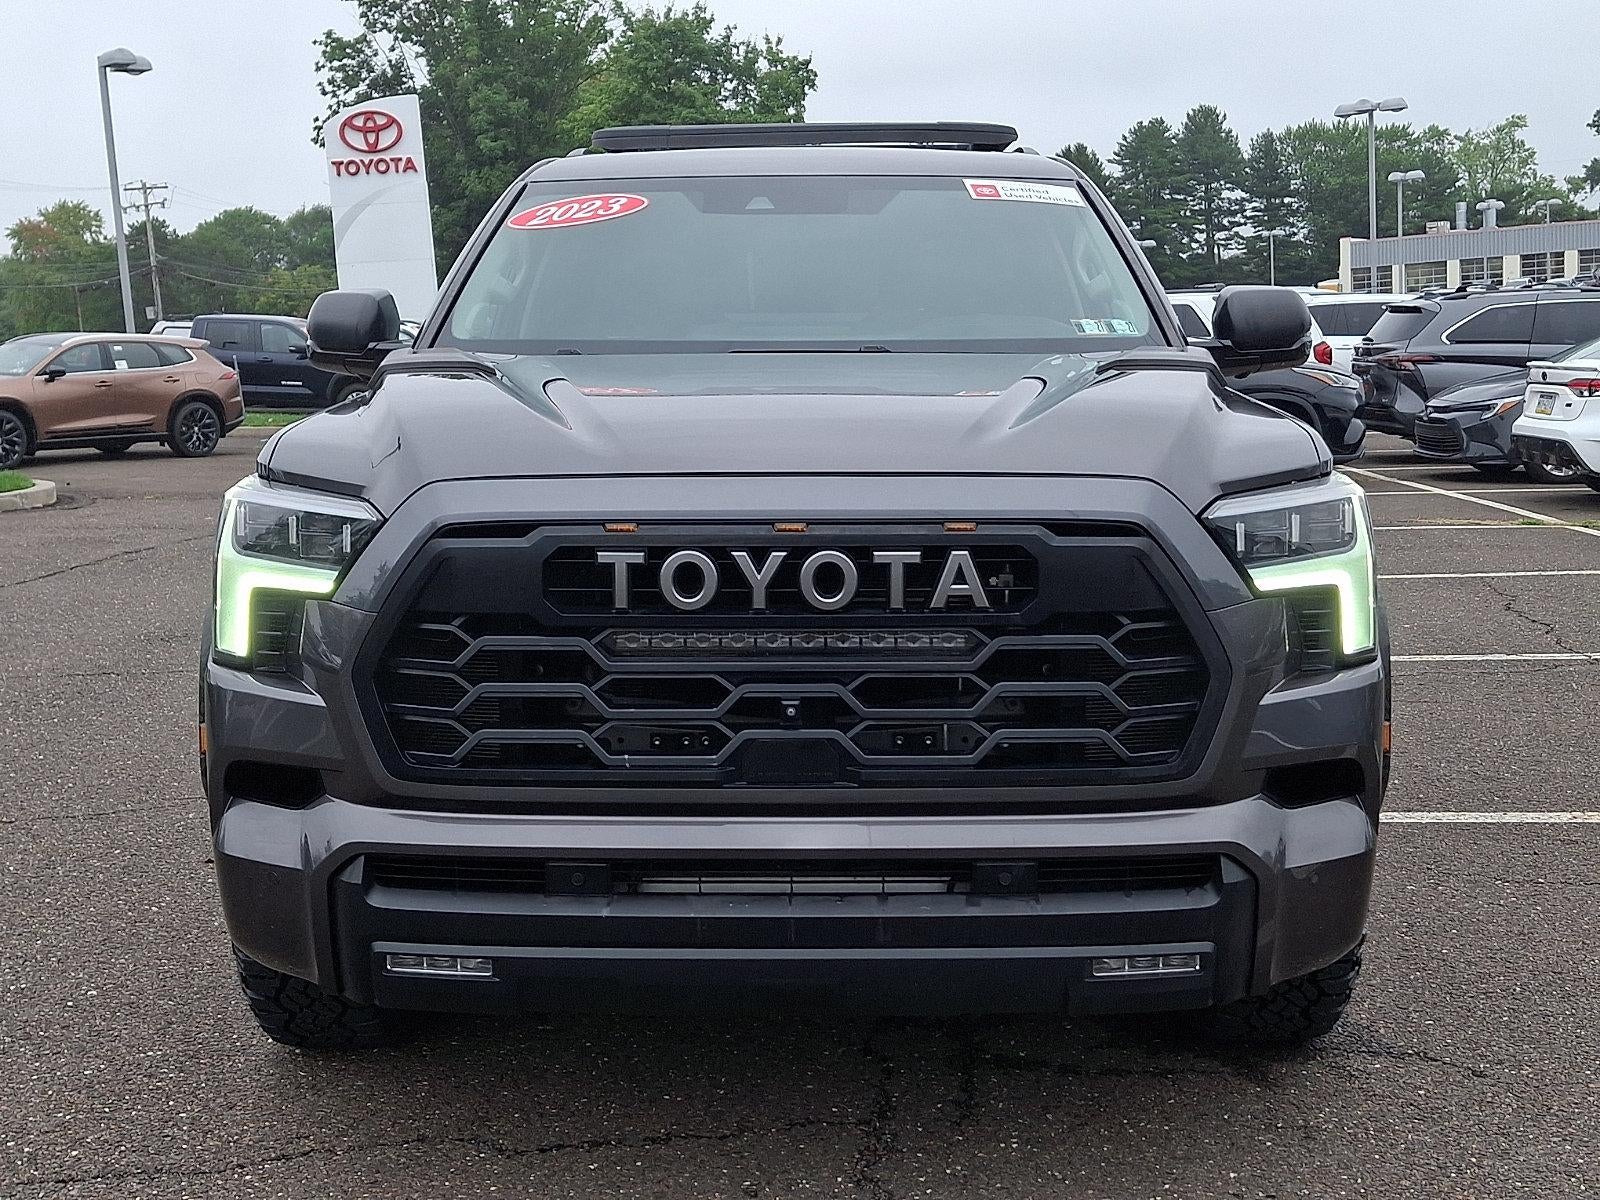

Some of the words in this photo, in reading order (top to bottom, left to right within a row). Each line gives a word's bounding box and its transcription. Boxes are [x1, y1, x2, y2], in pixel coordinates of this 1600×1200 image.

[331, 157, 418, 177] TOYOTA
[1001, 185, 1049, 195] Certified
[1038, 194, 1079, 204] Vehicles
[525, 197, 628, 226] 2023
[596, 550, 991, 612] TOYOTA
